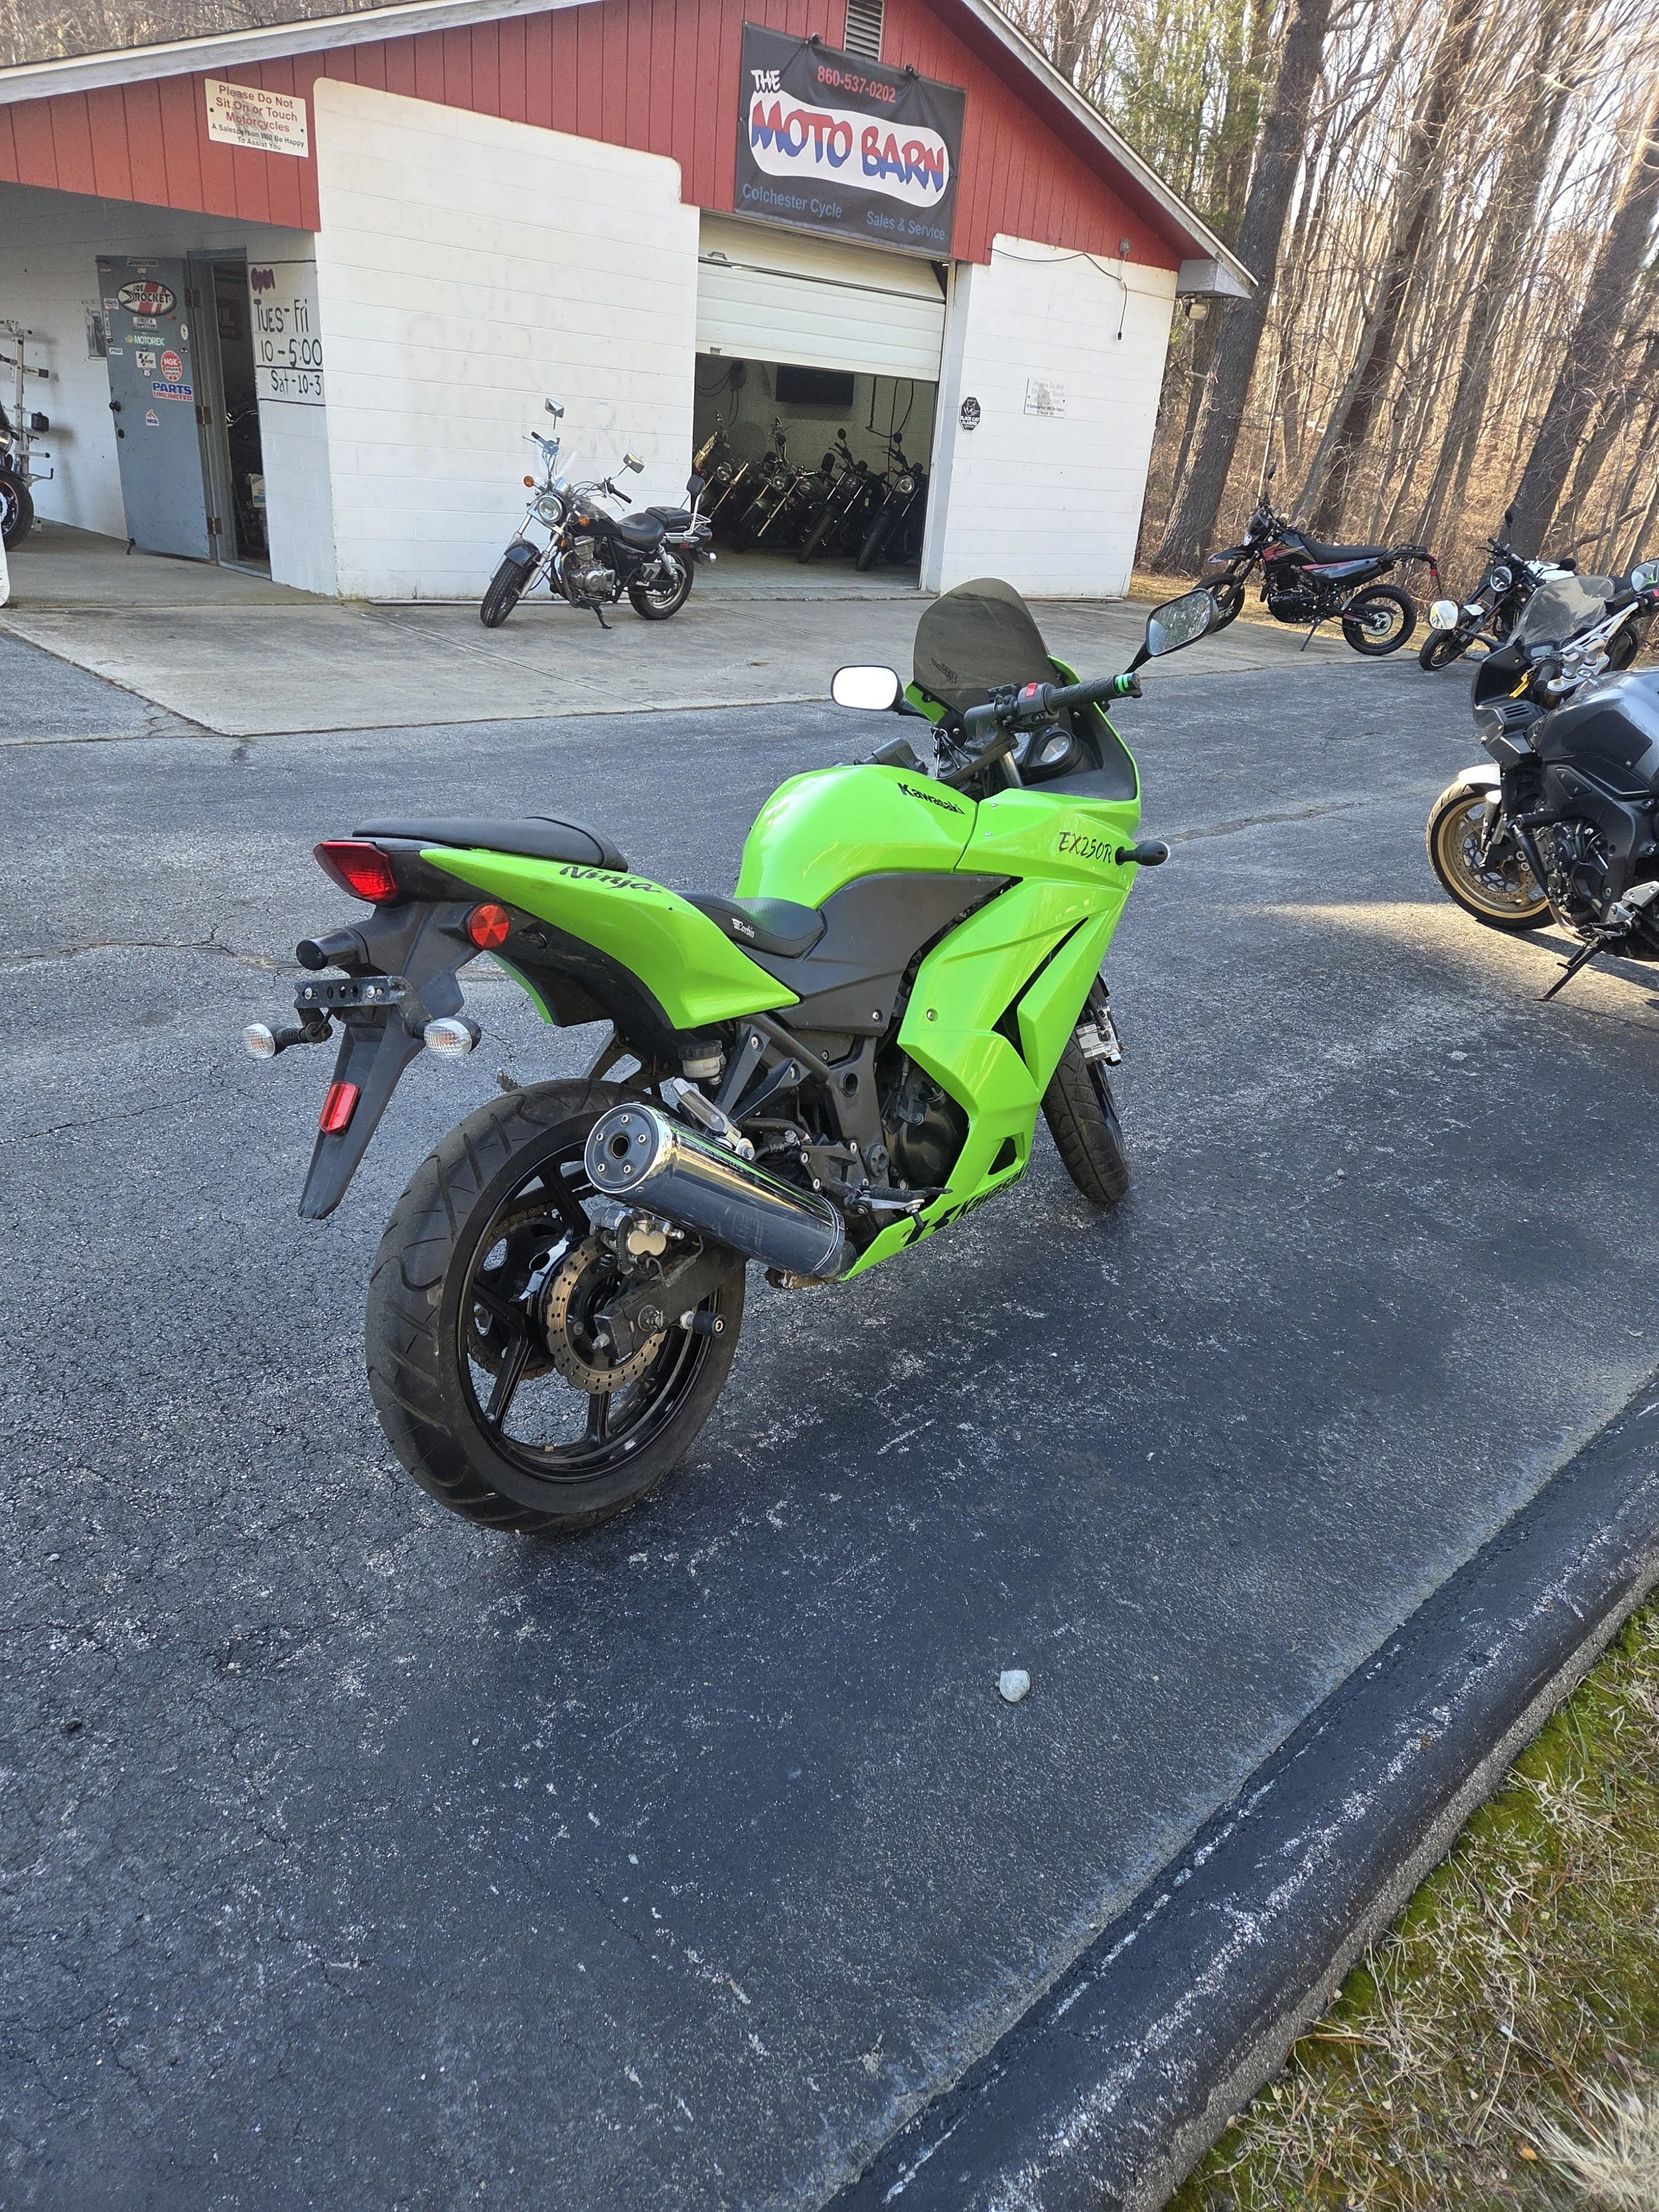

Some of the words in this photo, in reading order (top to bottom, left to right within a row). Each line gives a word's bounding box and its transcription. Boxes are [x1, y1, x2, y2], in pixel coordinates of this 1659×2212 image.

[751, 69, 781, 94] THE
[817, 65, 896, 104] 860-537-0202
[218, 84, 255, 100] Please
[257, 92, 272, 104] Do
[275, 96, 294, 109] Not
[216, 97, 231, 109] Sit
[234, 100, 249, 112] On
[252, 106, 263, 115] or
[266, 106, 298, 122] Touch
[226, 111, 290, 133] Motorcycles
[218, 125, 259, 138] Salesperson
[260, 132, 273, 141] Will
[274, 135, 283, 143] Be
[284, 137, 305, 149] Happy
[237, 135, 246, 144] To
[247, 137, 267, 148] Assist
[751, 100, 853, 168] MOTO
[861, 125, 944, 193] BARN
[742, 183, 808, 211] Colchester
[810, 202, 843, 219] Cycle
[866, 210, 895, 230] Sales
[897, 218, 906, 232] &
[908, 220, 946, 240] Service
[133, 292, 171, 303] ROCKET
[134, 335, 165, 346] MOTOREX
[163, 356, 179, 366] NGK
[152, 382, 192, 395] PARTS
[153, 391, 192, 402] UNLIMITED
[897, 782, 966, 815] Kawasaki
[1058, 832, 1113, 864] EX250R
[559, 865, 662, 894] Ninja
